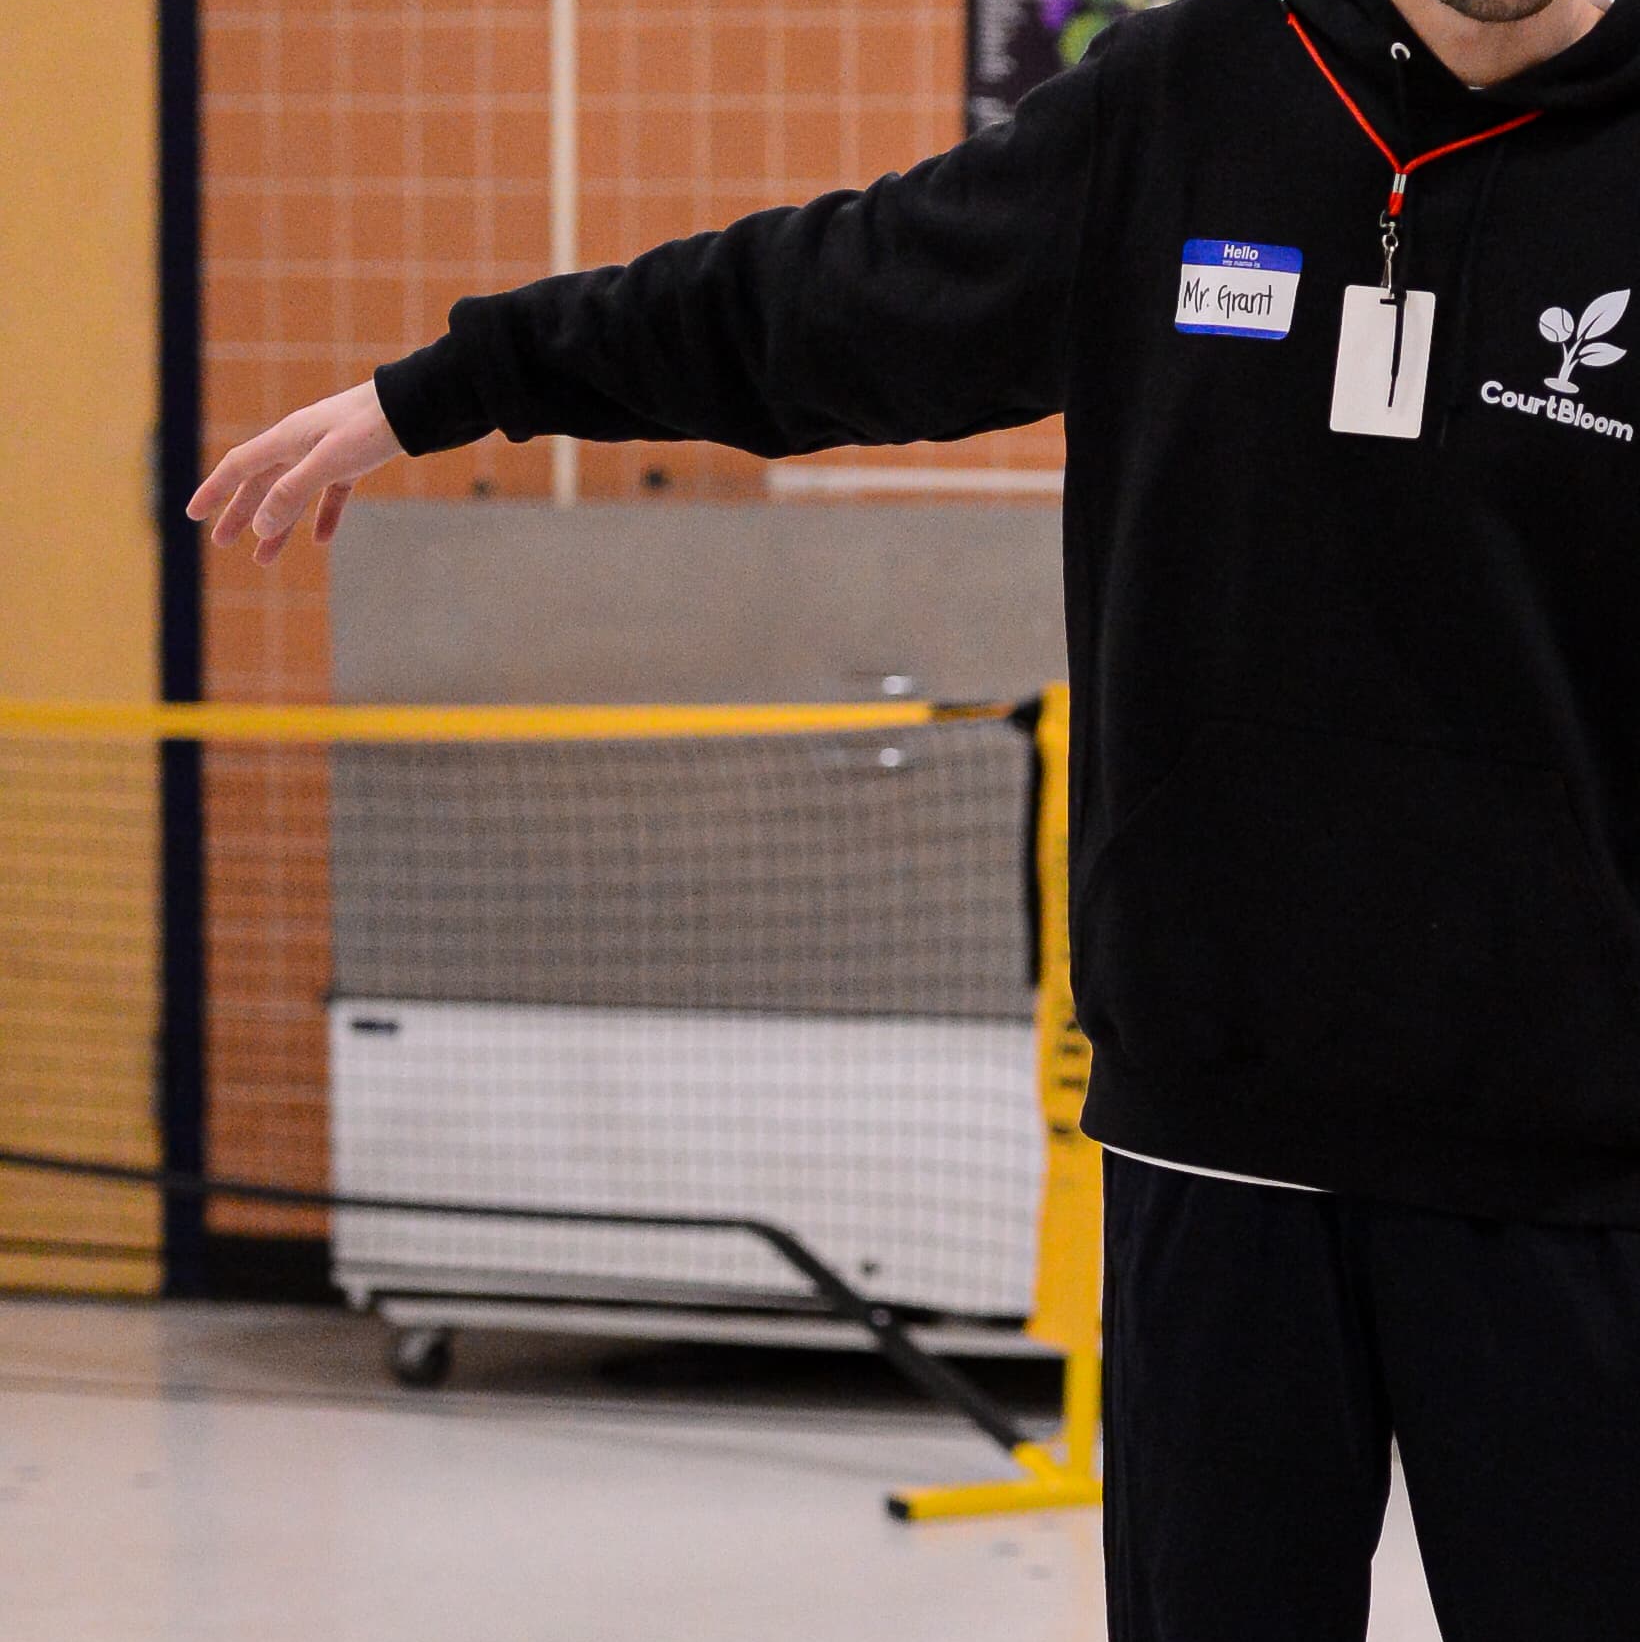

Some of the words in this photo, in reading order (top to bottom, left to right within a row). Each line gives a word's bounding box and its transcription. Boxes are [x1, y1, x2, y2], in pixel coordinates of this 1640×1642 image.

[1223, 243, 1259, 261] Hello
[1183, 277, 1210, 313] Mr.
[1217, 284, 1274, 319] Grant
[1480, 380, 1634, 442] CourtBloom
